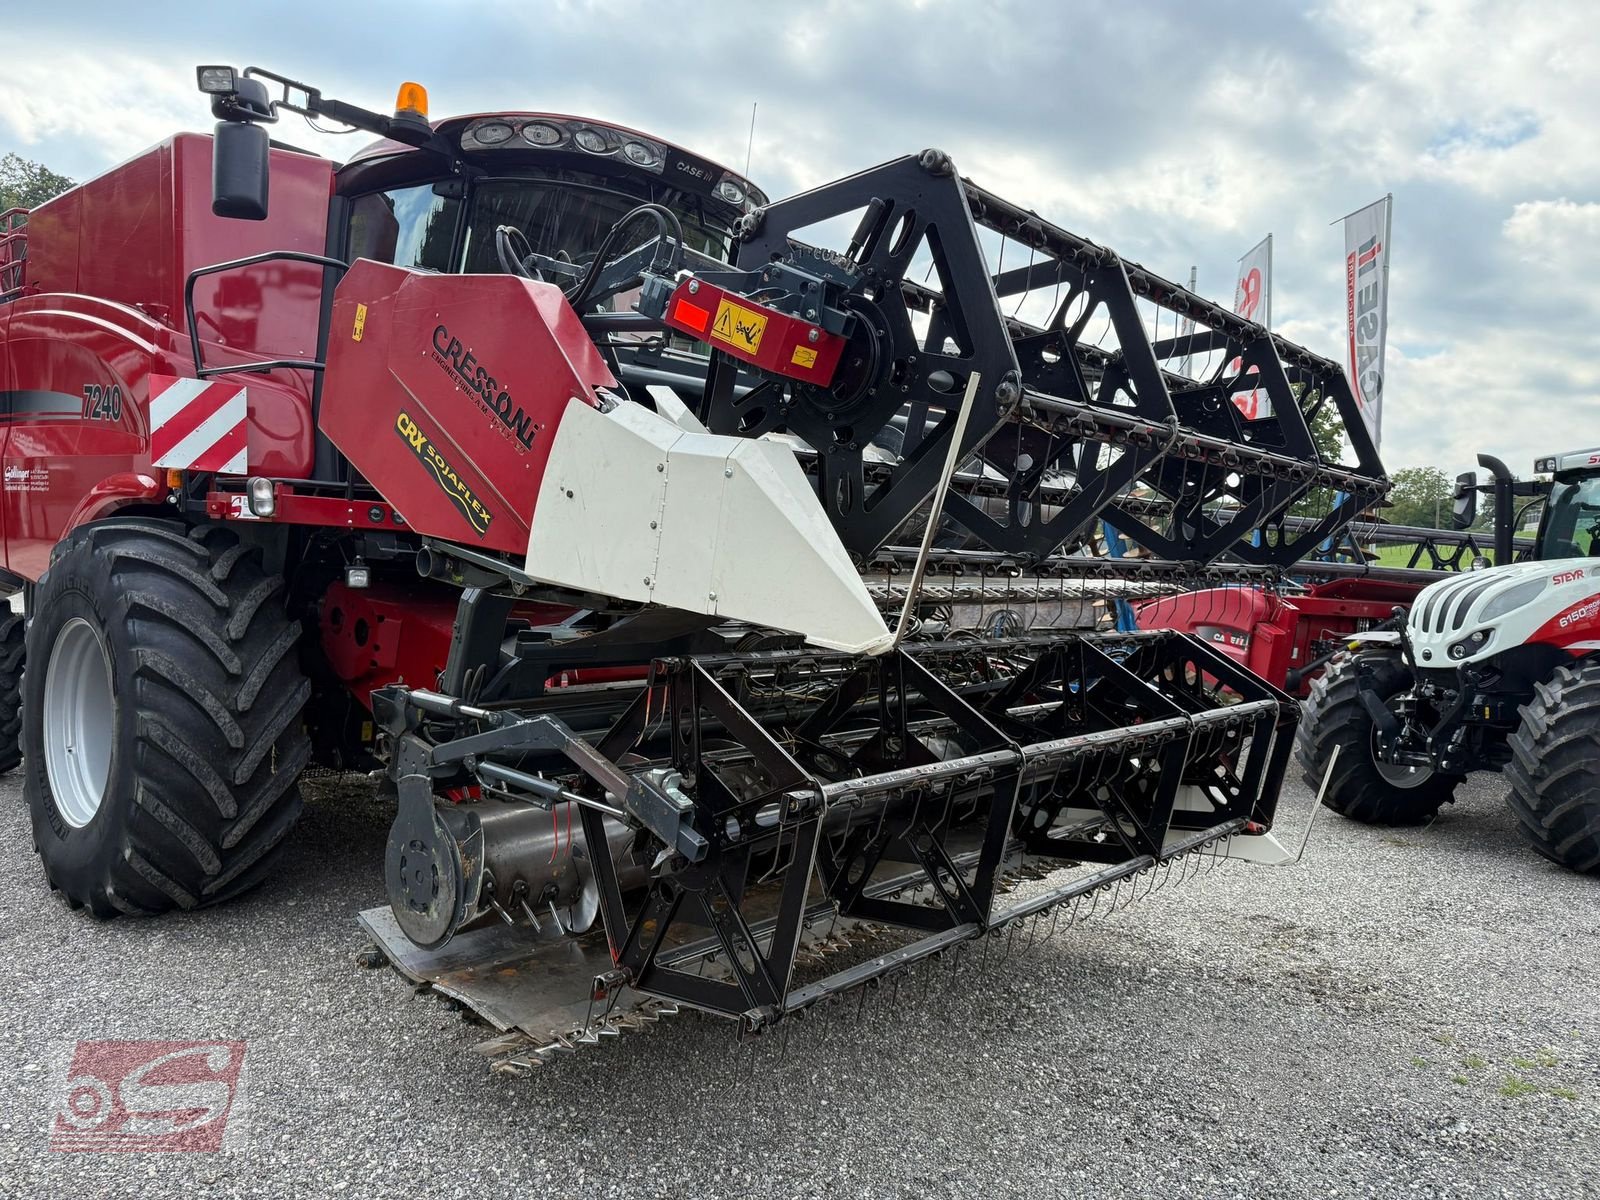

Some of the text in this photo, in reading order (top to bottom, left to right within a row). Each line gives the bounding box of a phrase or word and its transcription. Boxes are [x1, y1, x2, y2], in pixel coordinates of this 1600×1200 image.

[676, 161, 703, 178] CASE
[431, 351, 475, 400] ENGINEERING
[83, 384, 122, 422] 7240
[397, 413, 490, 524] CRX SOJAFLEX
[1552, 569, 1584, 585] STEYR
[1560, 608, 1586, 627] 6150
[1213, 633, 1237, 645] CAE
